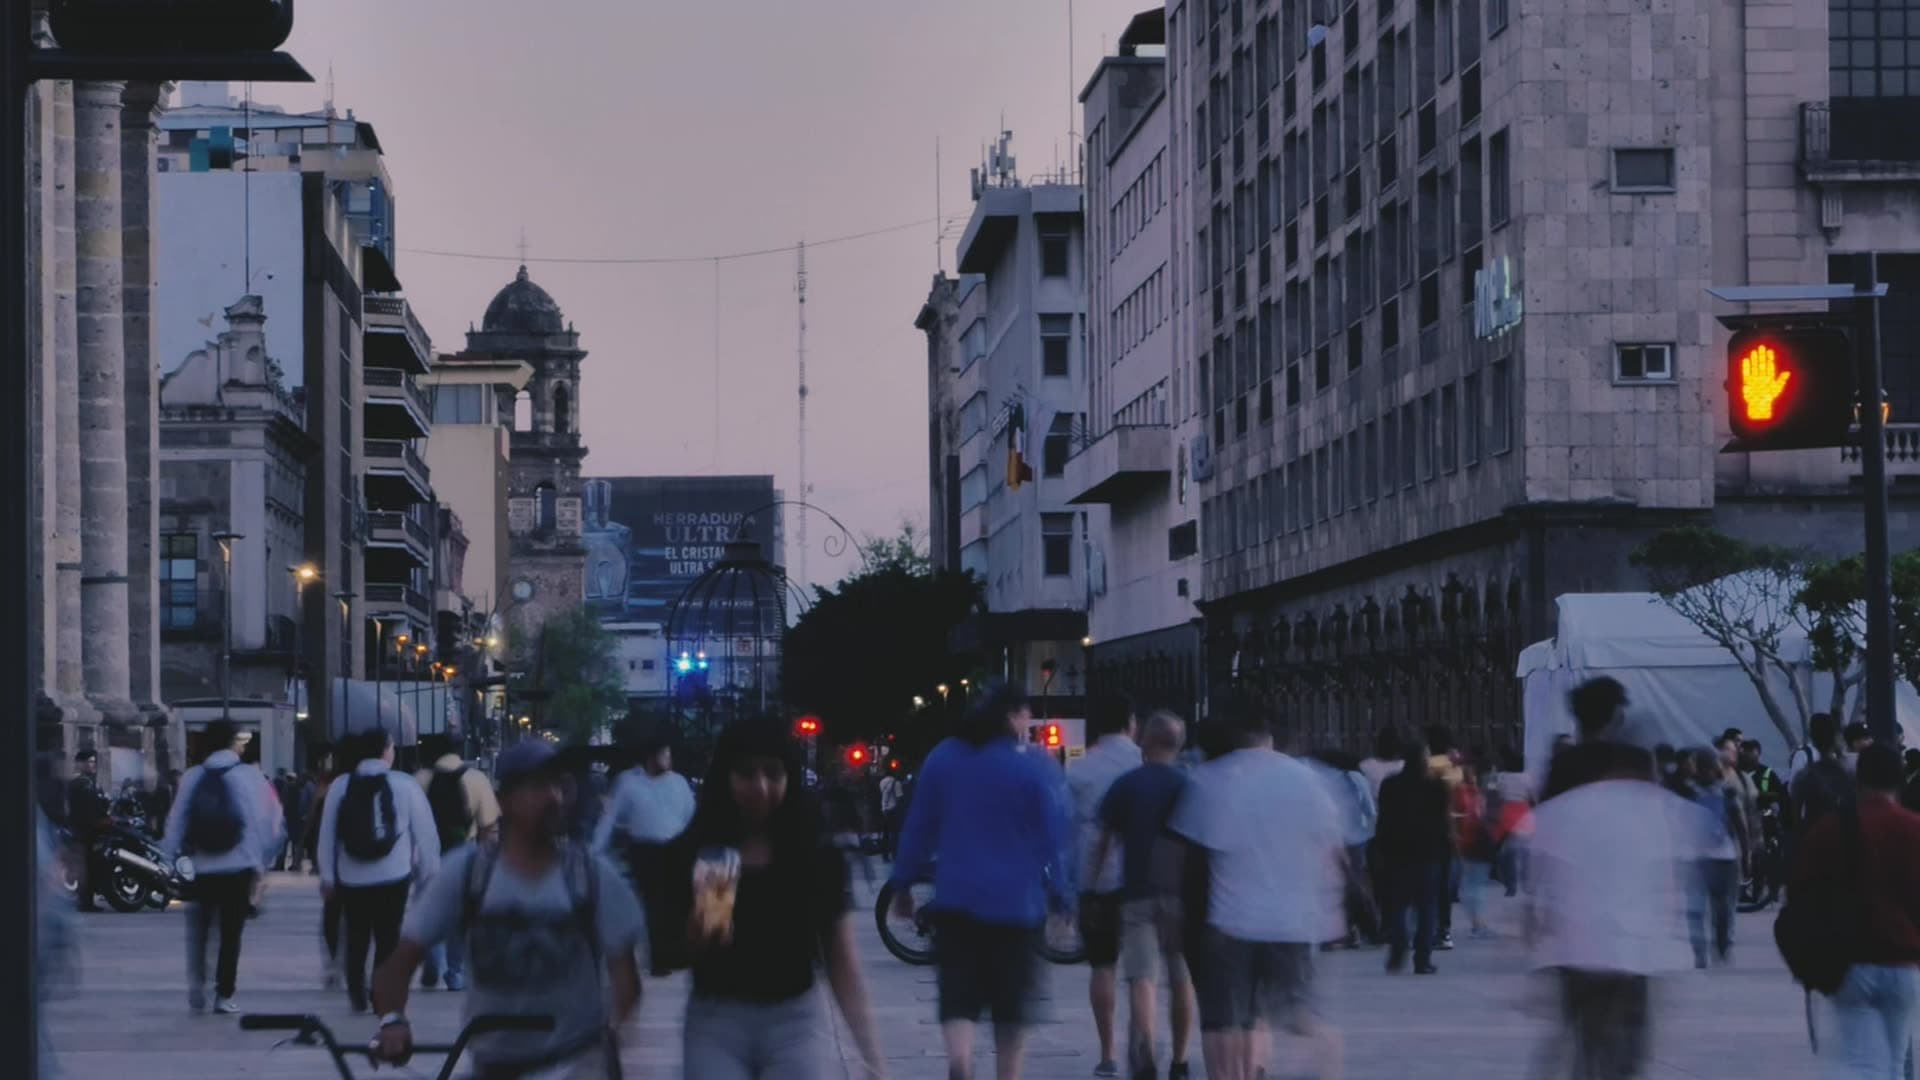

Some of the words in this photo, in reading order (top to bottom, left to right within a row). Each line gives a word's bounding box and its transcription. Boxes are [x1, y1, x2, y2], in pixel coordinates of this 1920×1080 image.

[654, 512, 756, 525] HERRADURA
[664, 547, 678, 560] EL
[670, 561, 705, 575] ULTRA
